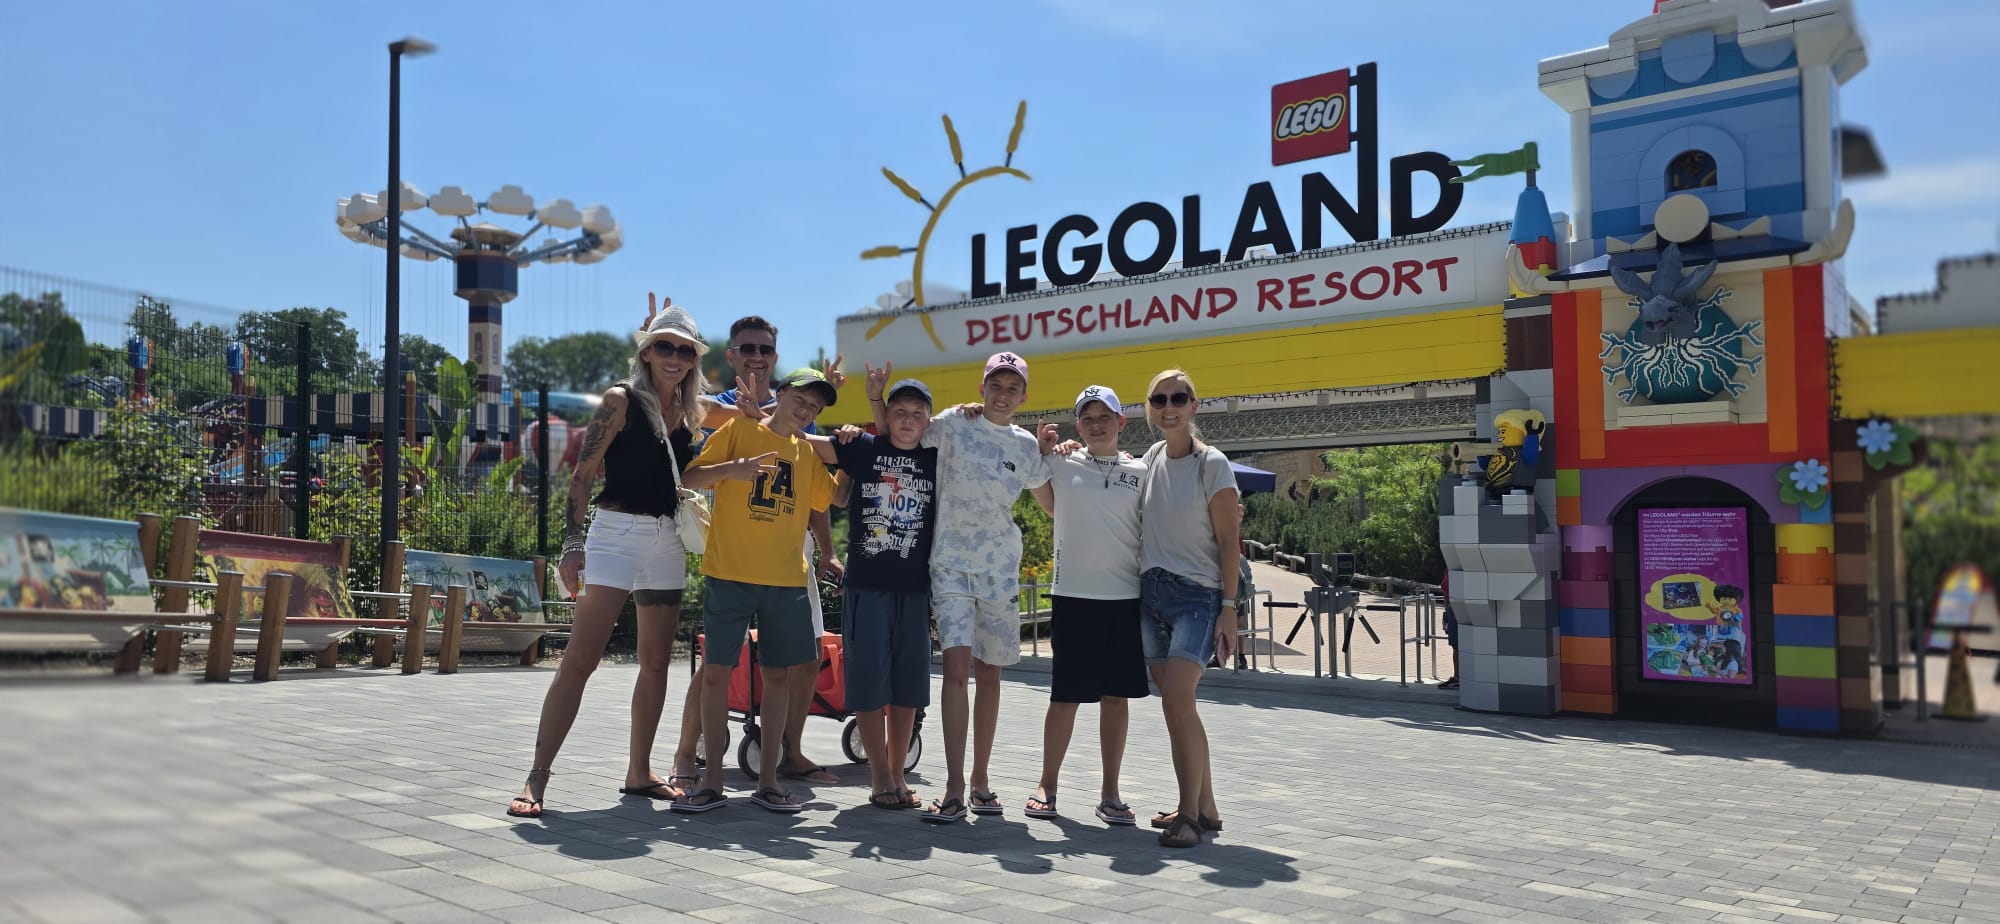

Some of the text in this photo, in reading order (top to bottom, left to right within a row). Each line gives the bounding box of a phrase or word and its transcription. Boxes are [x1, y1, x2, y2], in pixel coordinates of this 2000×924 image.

[1276, 97, 1344, 138] LEGO
[971, 62, 1464, 299] LEGOLAND
[966, 256, 1459, 346] DEUTSCHLAND RESORT
[748, 458, 797, 516] LA
